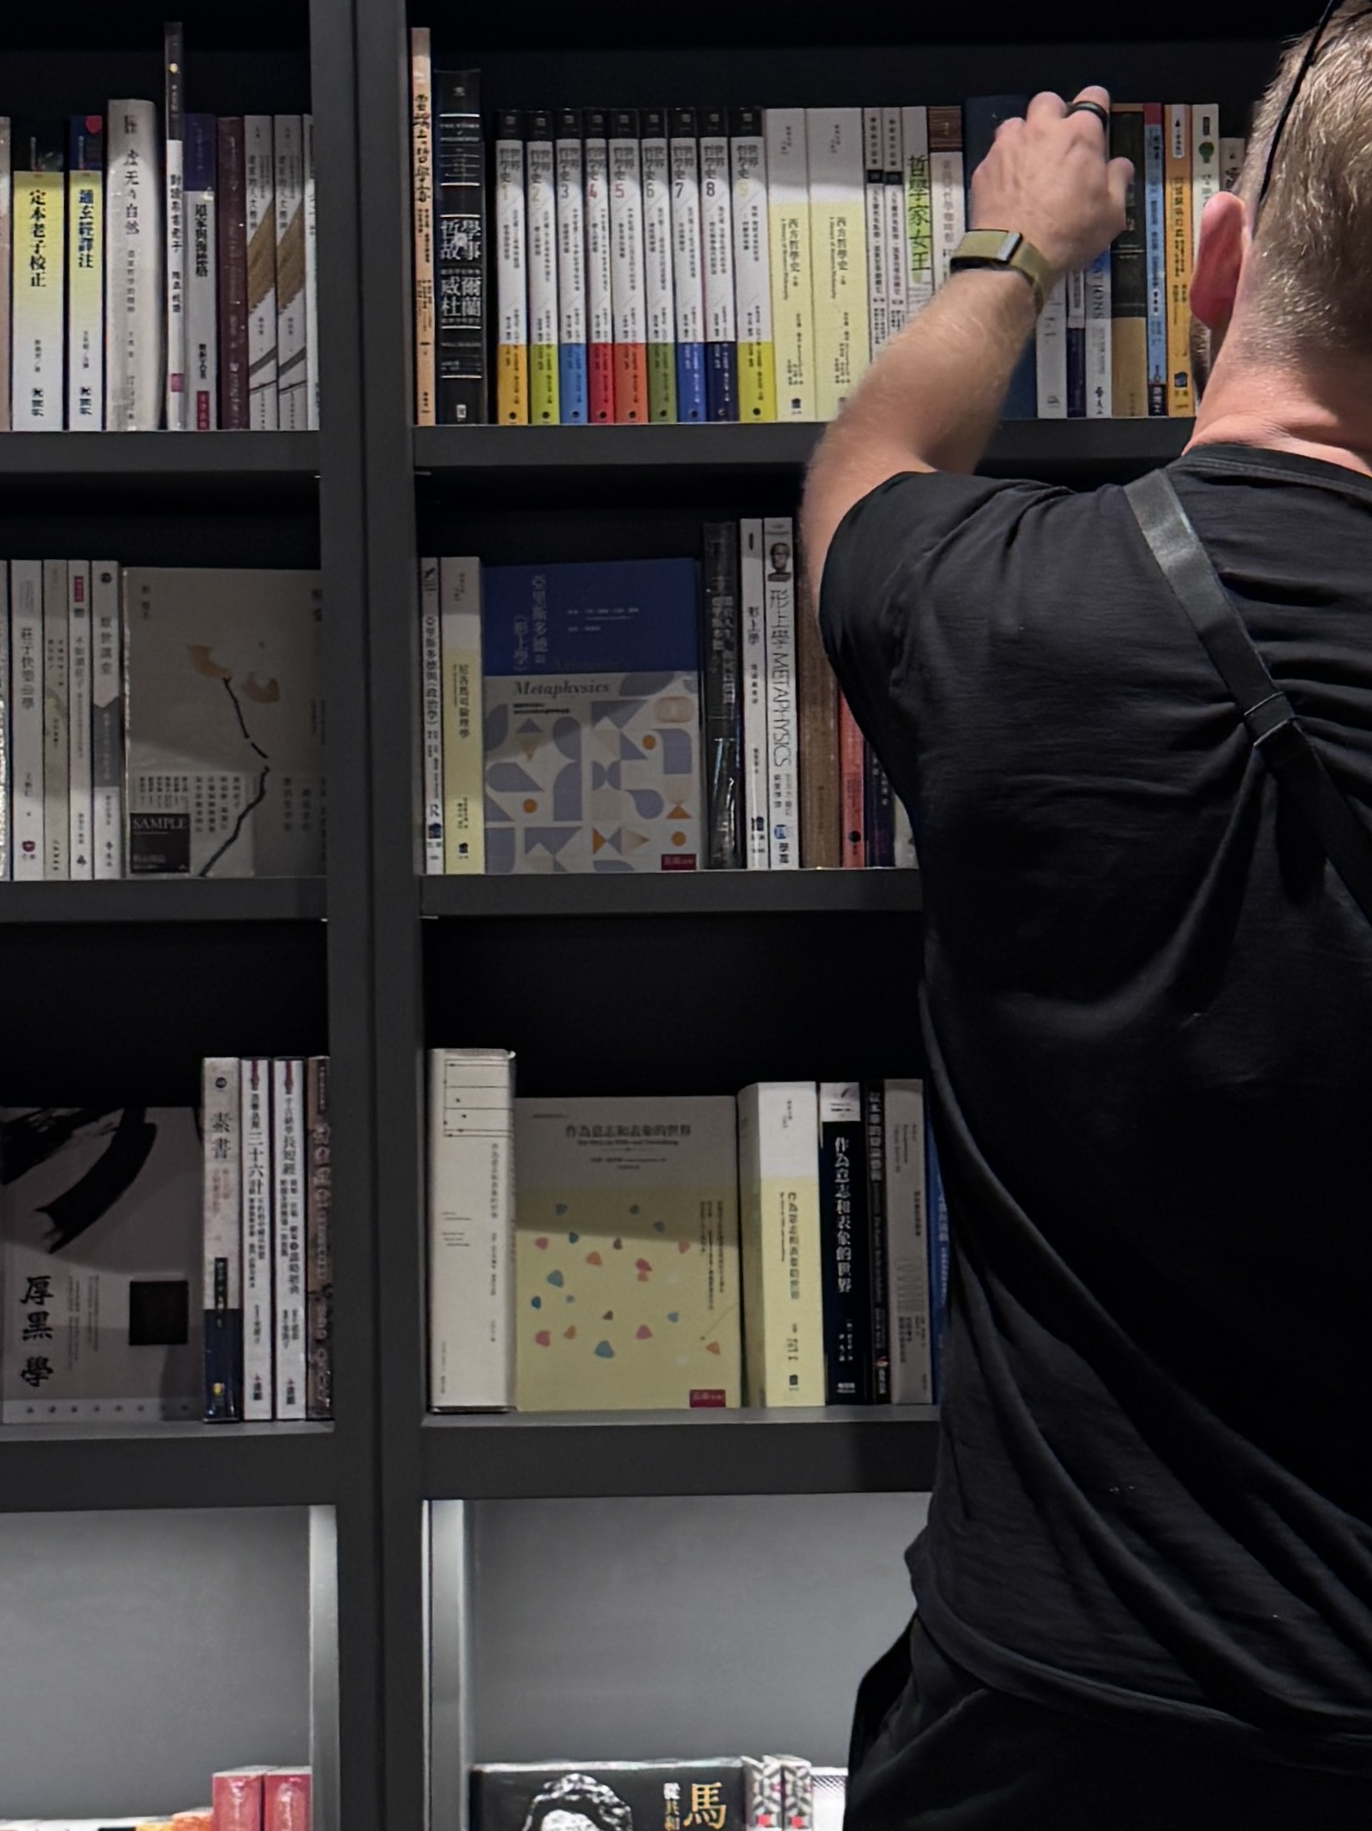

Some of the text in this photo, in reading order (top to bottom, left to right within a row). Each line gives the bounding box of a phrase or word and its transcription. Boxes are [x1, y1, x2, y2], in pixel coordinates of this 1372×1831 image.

[501, 184, 509, 200] 1
[531, 186, 541, 202] 2
[560, 183, 569, 199] 3
[589, 183, 598, 199] 4
[615, 183, 624, 199] 5
[646, 183, 655, 199] 6
[675, 183, 683, 199] 7
[706, 182, 715, 197] 8
[908, 154, 931, 273] 哲學家女王
[513, 681, 611, 699] Metaphysics
[133, 817, 186, 831] SAMPLE
[211, 1111, 231, 1160] 素書
[834, 1136, 853, 1293] 作為意志和表象的世界
[21, 1275, 55, 1388] 厚黑學
